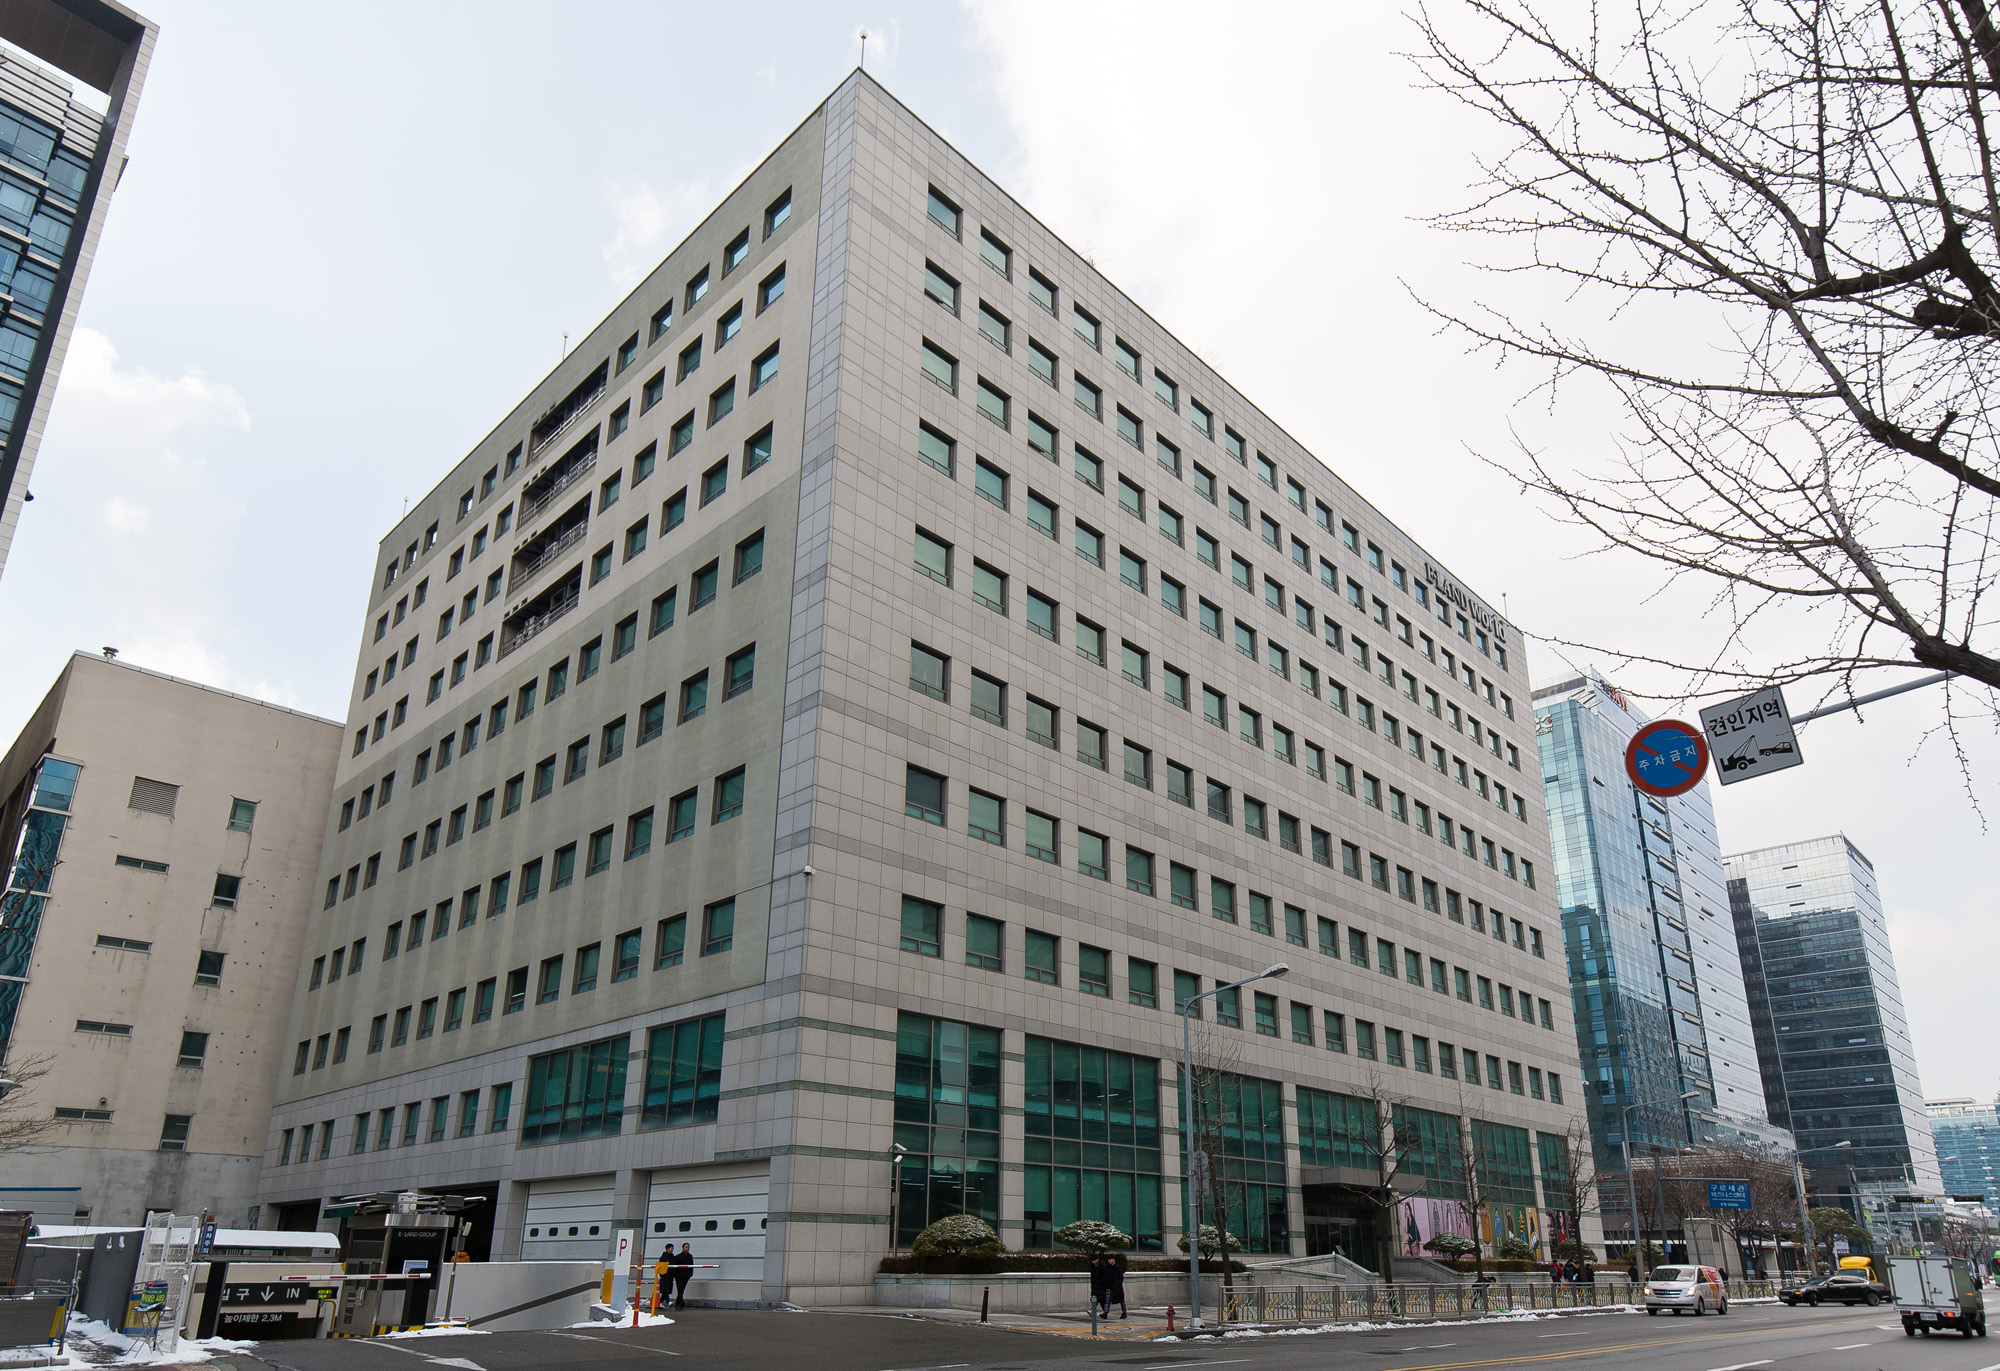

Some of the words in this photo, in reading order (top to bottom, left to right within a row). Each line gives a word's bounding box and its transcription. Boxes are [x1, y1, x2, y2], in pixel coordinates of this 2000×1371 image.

[1708, 699, 1783, 738] 견인지역
[1638, 744, 1697, 771] 주차금지
[619, 1238, 628, 1257] P
[286, 1287, 300, 1299] IN
